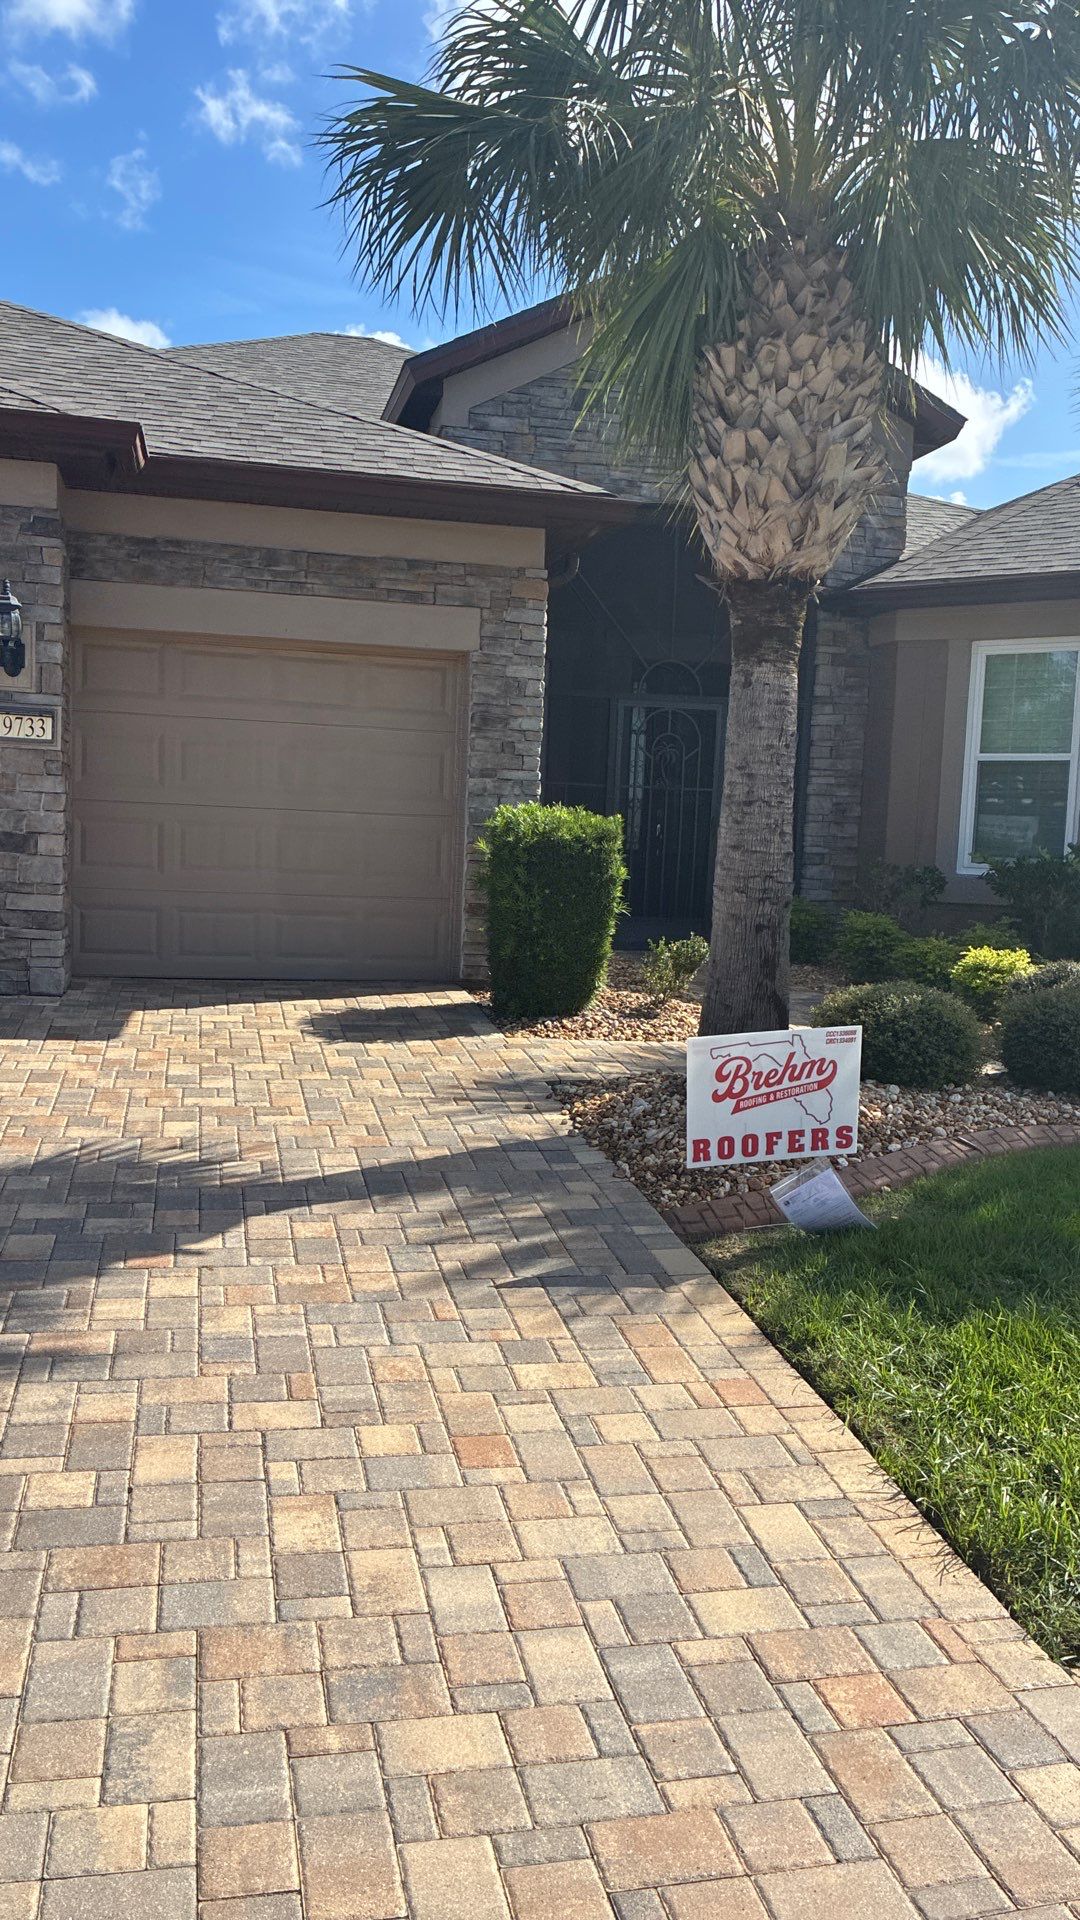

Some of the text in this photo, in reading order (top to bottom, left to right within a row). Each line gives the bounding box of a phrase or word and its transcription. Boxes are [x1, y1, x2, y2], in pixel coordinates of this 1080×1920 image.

[3, 716, 45, 738] 9733
[711, 1051, 837, 1103] Brehm
[739, 1081, 819, 1109] ROOFING & RESTORATION
[692, 1125, 854, 1163] ROOFERS
